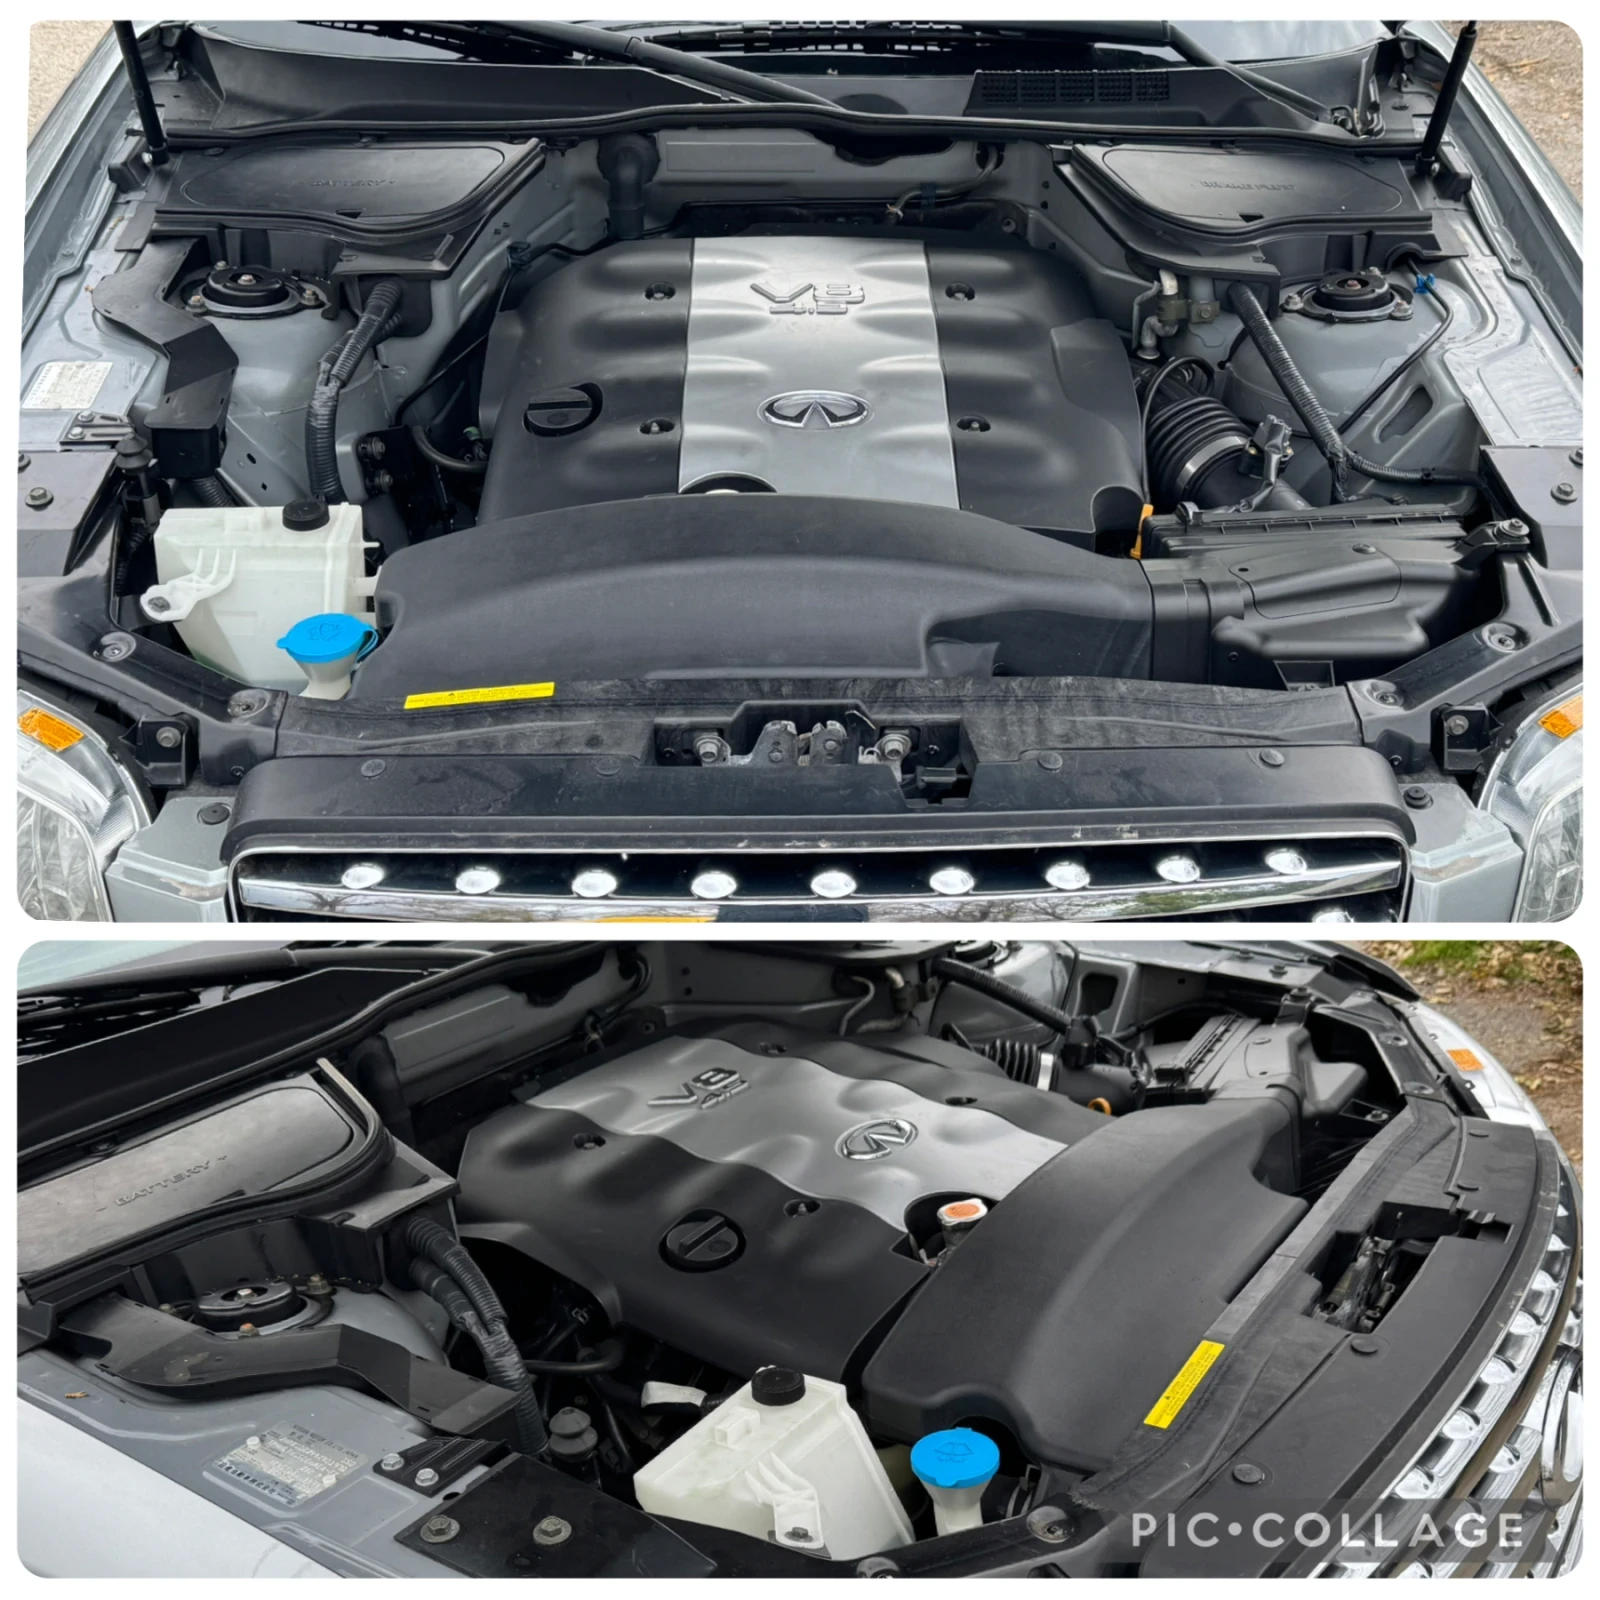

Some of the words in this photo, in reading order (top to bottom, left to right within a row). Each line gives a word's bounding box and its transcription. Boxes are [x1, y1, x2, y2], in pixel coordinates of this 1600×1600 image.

[749, 282, 866, 305] V8
[769, 300, 849, 316] 4.5
[646, 1066, 740, 1107] V8
[700, 1079, 750, 1111] 4.5
[114, 1160, 211, 1207] BATTERY
